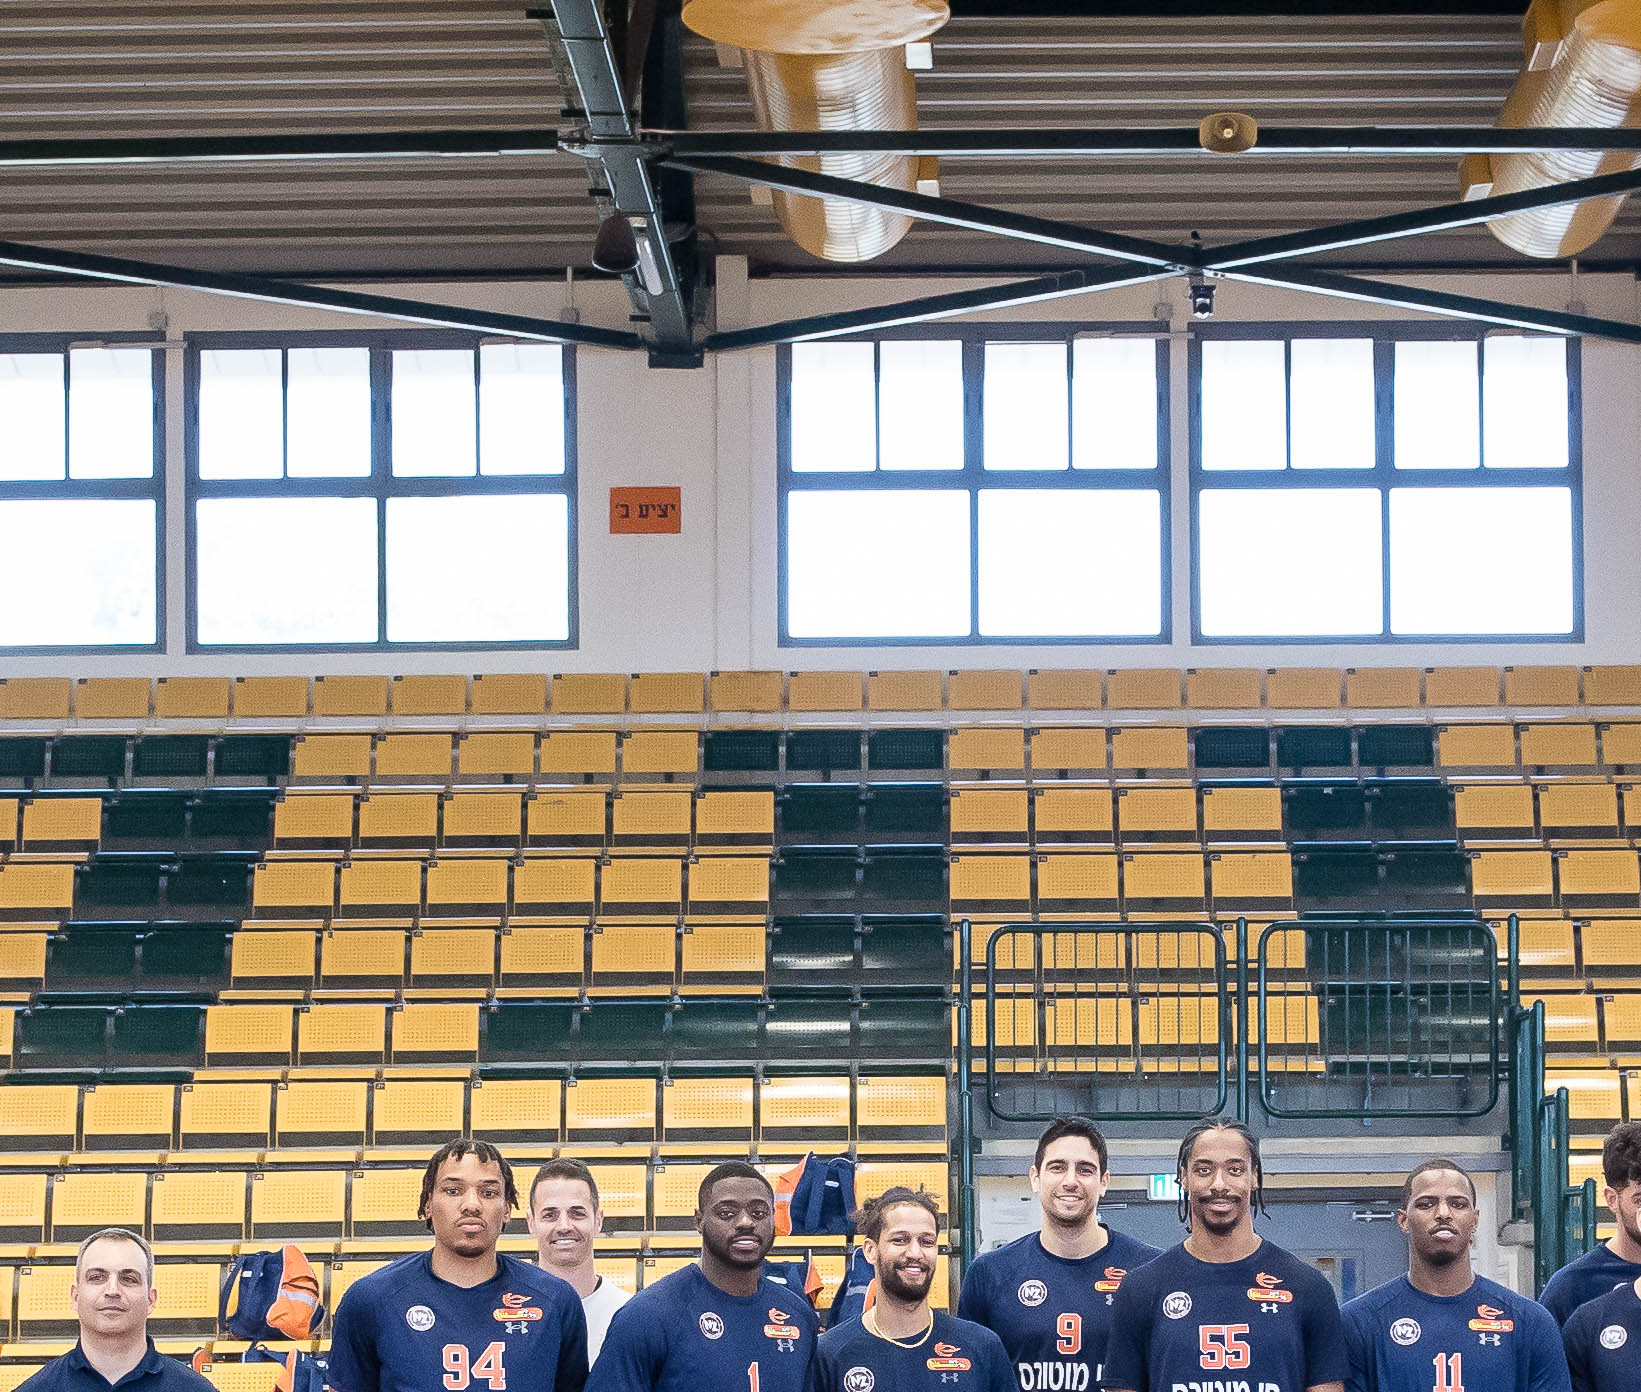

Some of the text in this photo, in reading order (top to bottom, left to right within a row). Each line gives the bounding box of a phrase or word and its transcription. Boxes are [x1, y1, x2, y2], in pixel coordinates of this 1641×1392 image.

[1056, 1313, 1082, 1355] 9
[1198, 1324, 1251, 1370] 55
[442, 1341, 507, 1391] 94
[1018, 1361, 1089, 1392] מוטורס
